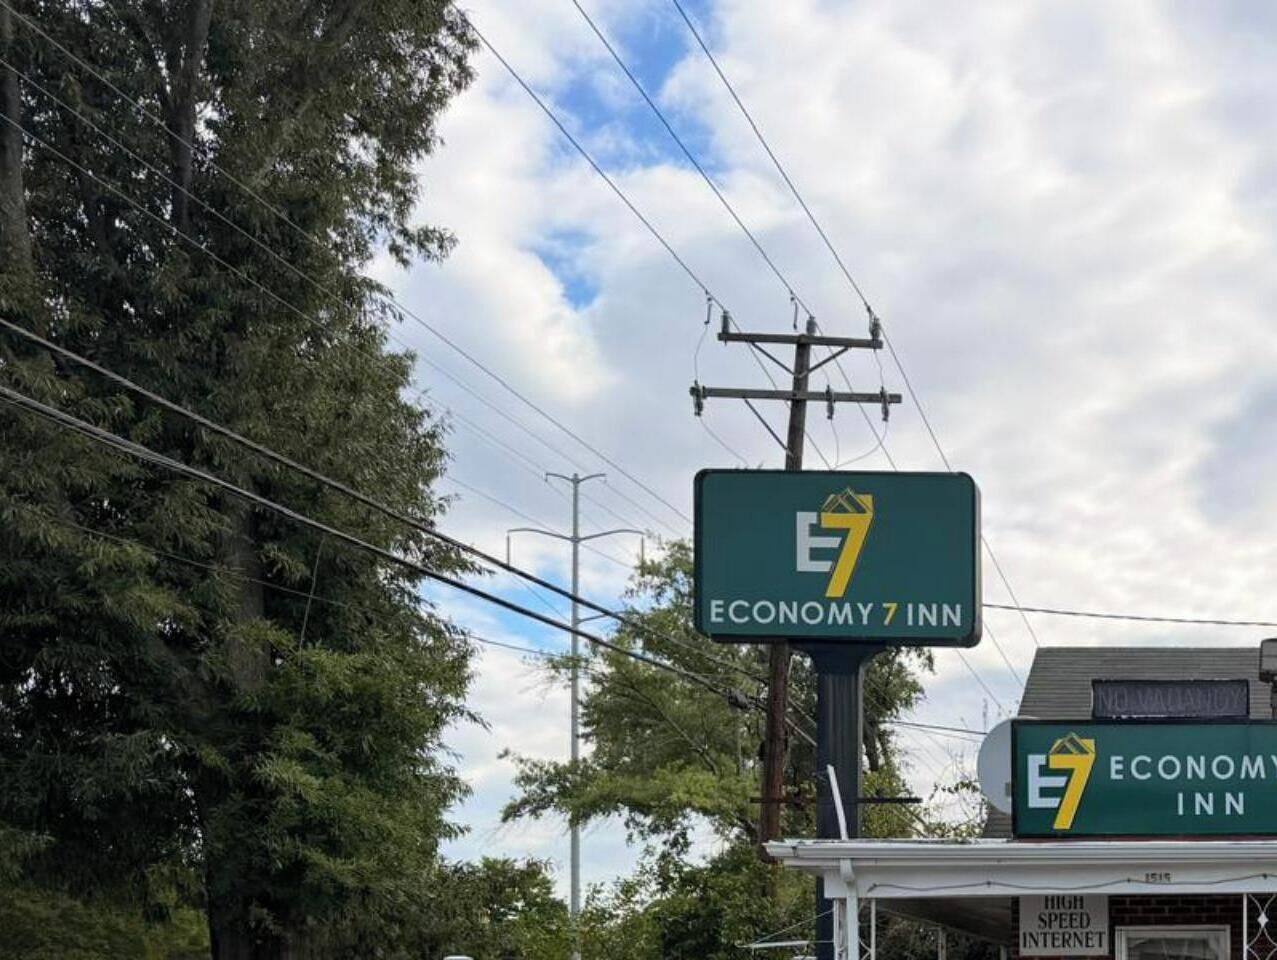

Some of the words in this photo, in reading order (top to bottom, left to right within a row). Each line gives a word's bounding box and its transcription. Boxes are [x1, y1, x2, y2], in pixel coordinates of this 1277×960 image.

[709, 599, 873, 625] ECONOMY
[882, 602, 898, 626] 7
[907, 603, 962, 627] INN
[1177, 792, 1245, 816] INN
[1044, 896, 1084, 910] HIGH
[1038, 912, 1091, 929] SPEED
[1022, 931, 1106, 949] INTERNET
